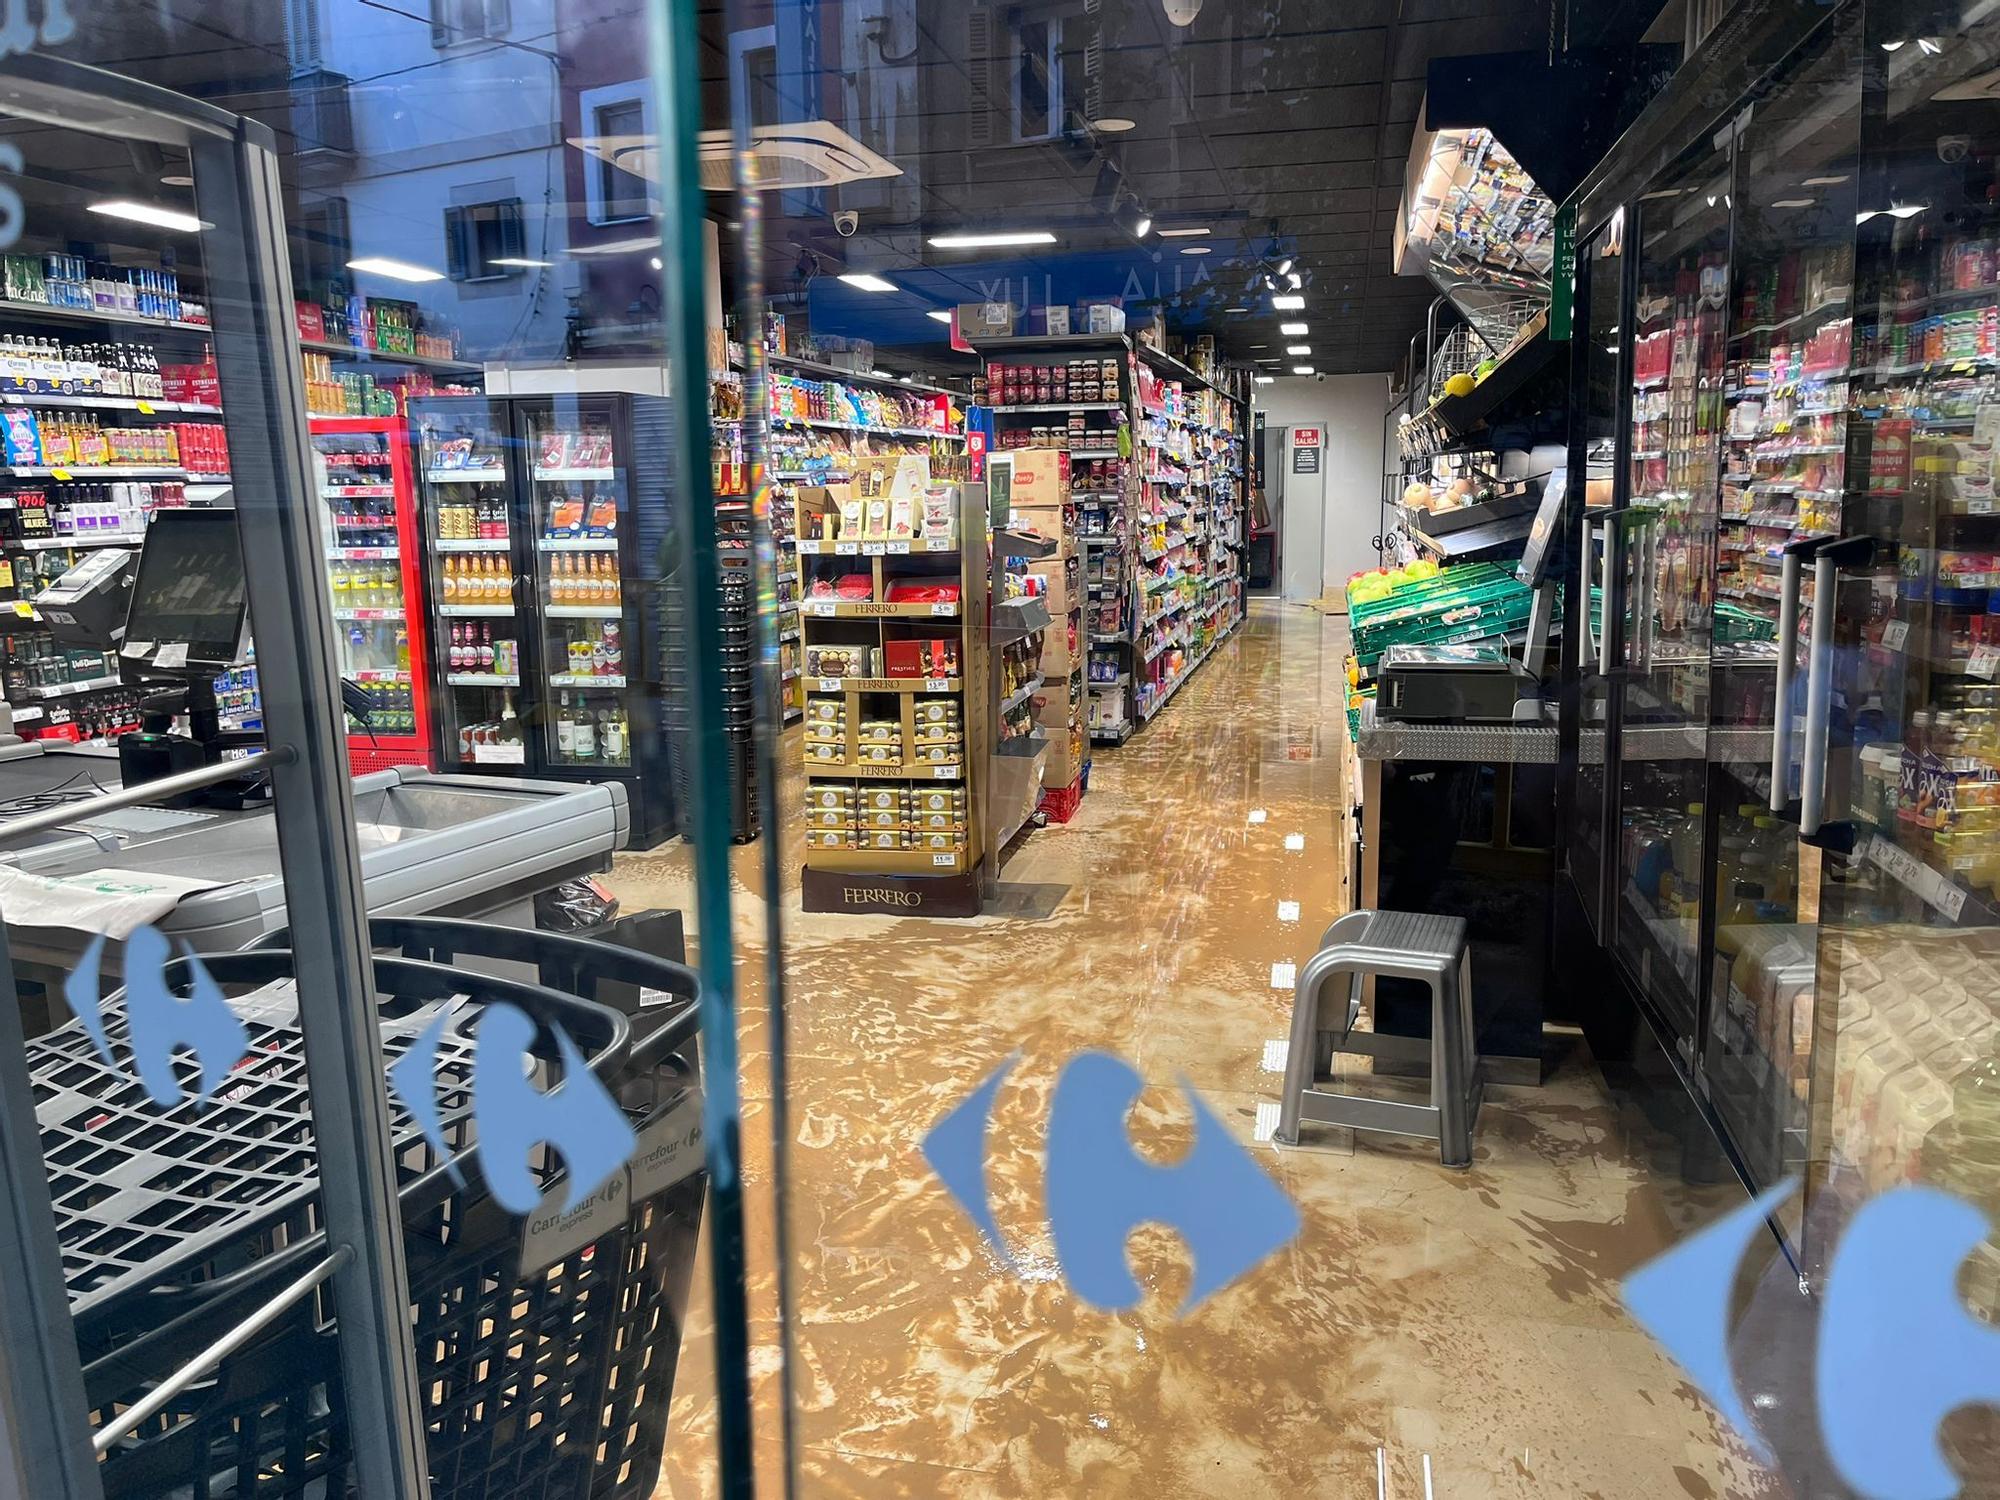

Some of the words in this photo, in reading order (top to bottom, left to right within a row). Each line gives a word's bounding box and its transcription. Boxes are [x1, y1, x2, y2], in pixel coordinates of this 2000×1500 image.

[191, 378, 217, 387] ESTRELLA
[17, 494, 46, 508] 1906
[855, 603, 898, 614] FERRERO
[857, 679, 901, 690] FERRERO
[861, 766, 904, 776] FERRERO
[843, 887, 922, 907] FERRERO
[647, 1154, 677, 1172] express
[531, 1194, 596, 1235] Carrour
[559, 1211, 594, 1233] express
